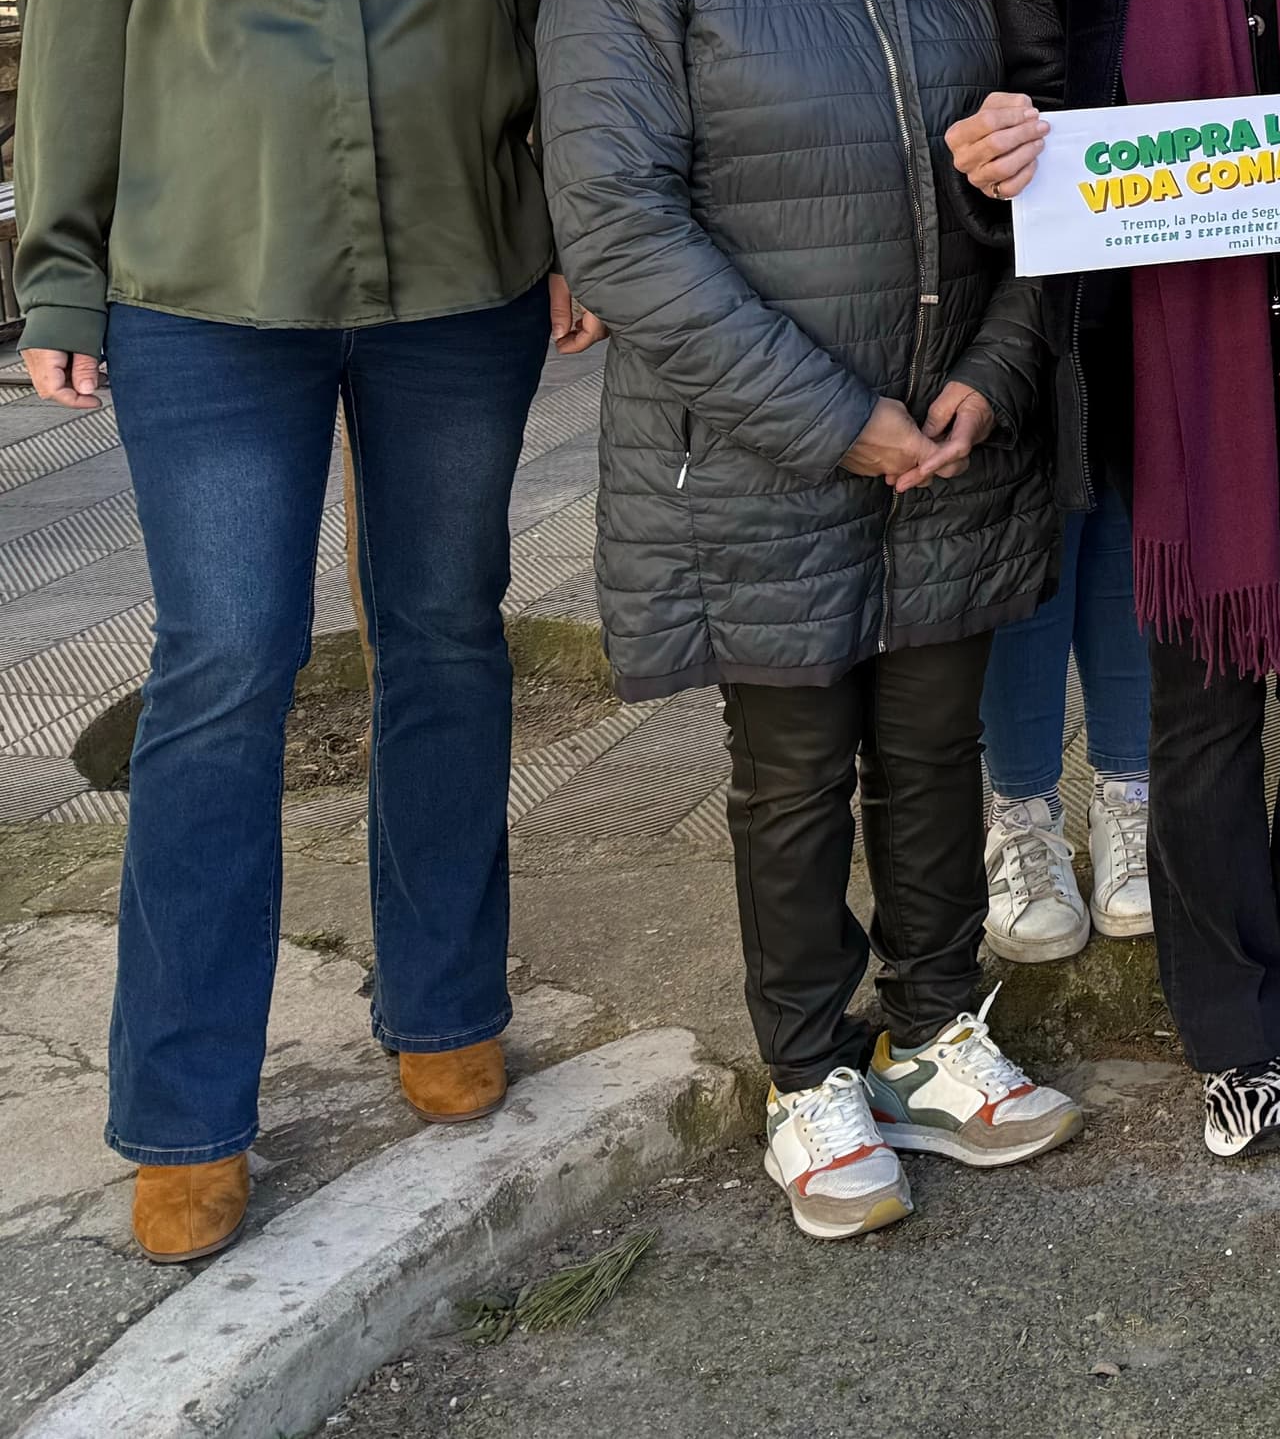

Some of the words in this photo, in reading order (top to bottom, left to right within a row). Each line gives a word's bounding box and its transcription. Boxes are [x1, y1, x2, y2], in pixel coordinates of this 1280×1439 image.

[1084, 118, 1262, 175] COMPRA
[1077, 168, 1183, 213] VIDA
[1120, 216, 1170, 231] Tremp,
[1174, 214, 1186, 226] la
[1190, 211, 1228, 225] Pobla
[1231, 209, 1249, 221] de
[1105, 230, 1180, 247] SORTEGEM
[1184, 229, 1193, 240] 3
[1228, 235, 1254, 250] mai
